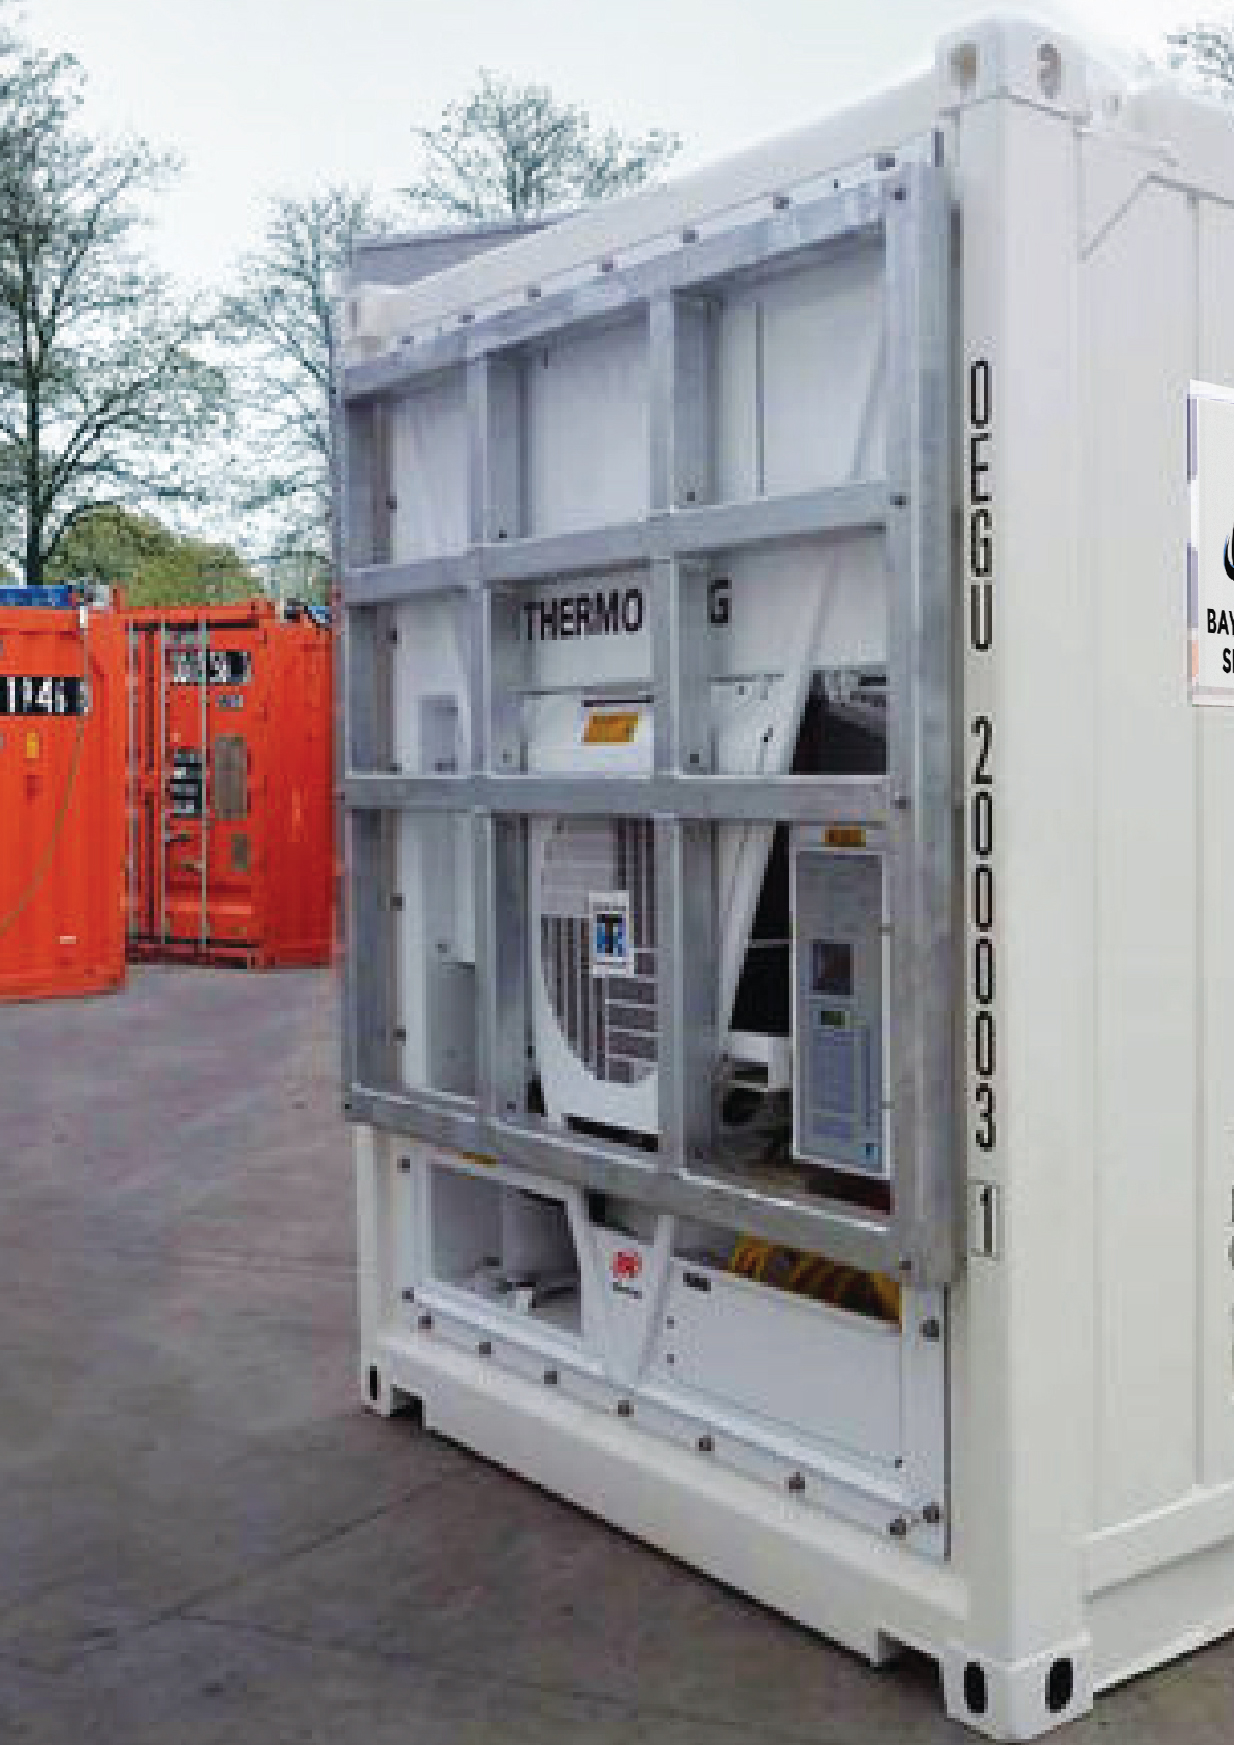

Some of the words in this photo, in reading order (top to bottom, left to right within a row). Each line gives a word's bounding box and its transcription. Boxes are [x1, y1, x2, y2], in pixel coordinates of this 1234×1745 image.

[522, 588, 643, 641] THERMO
[970, 358, 993, 652] OEGU
[970, 715, 996, 1153] 200003
